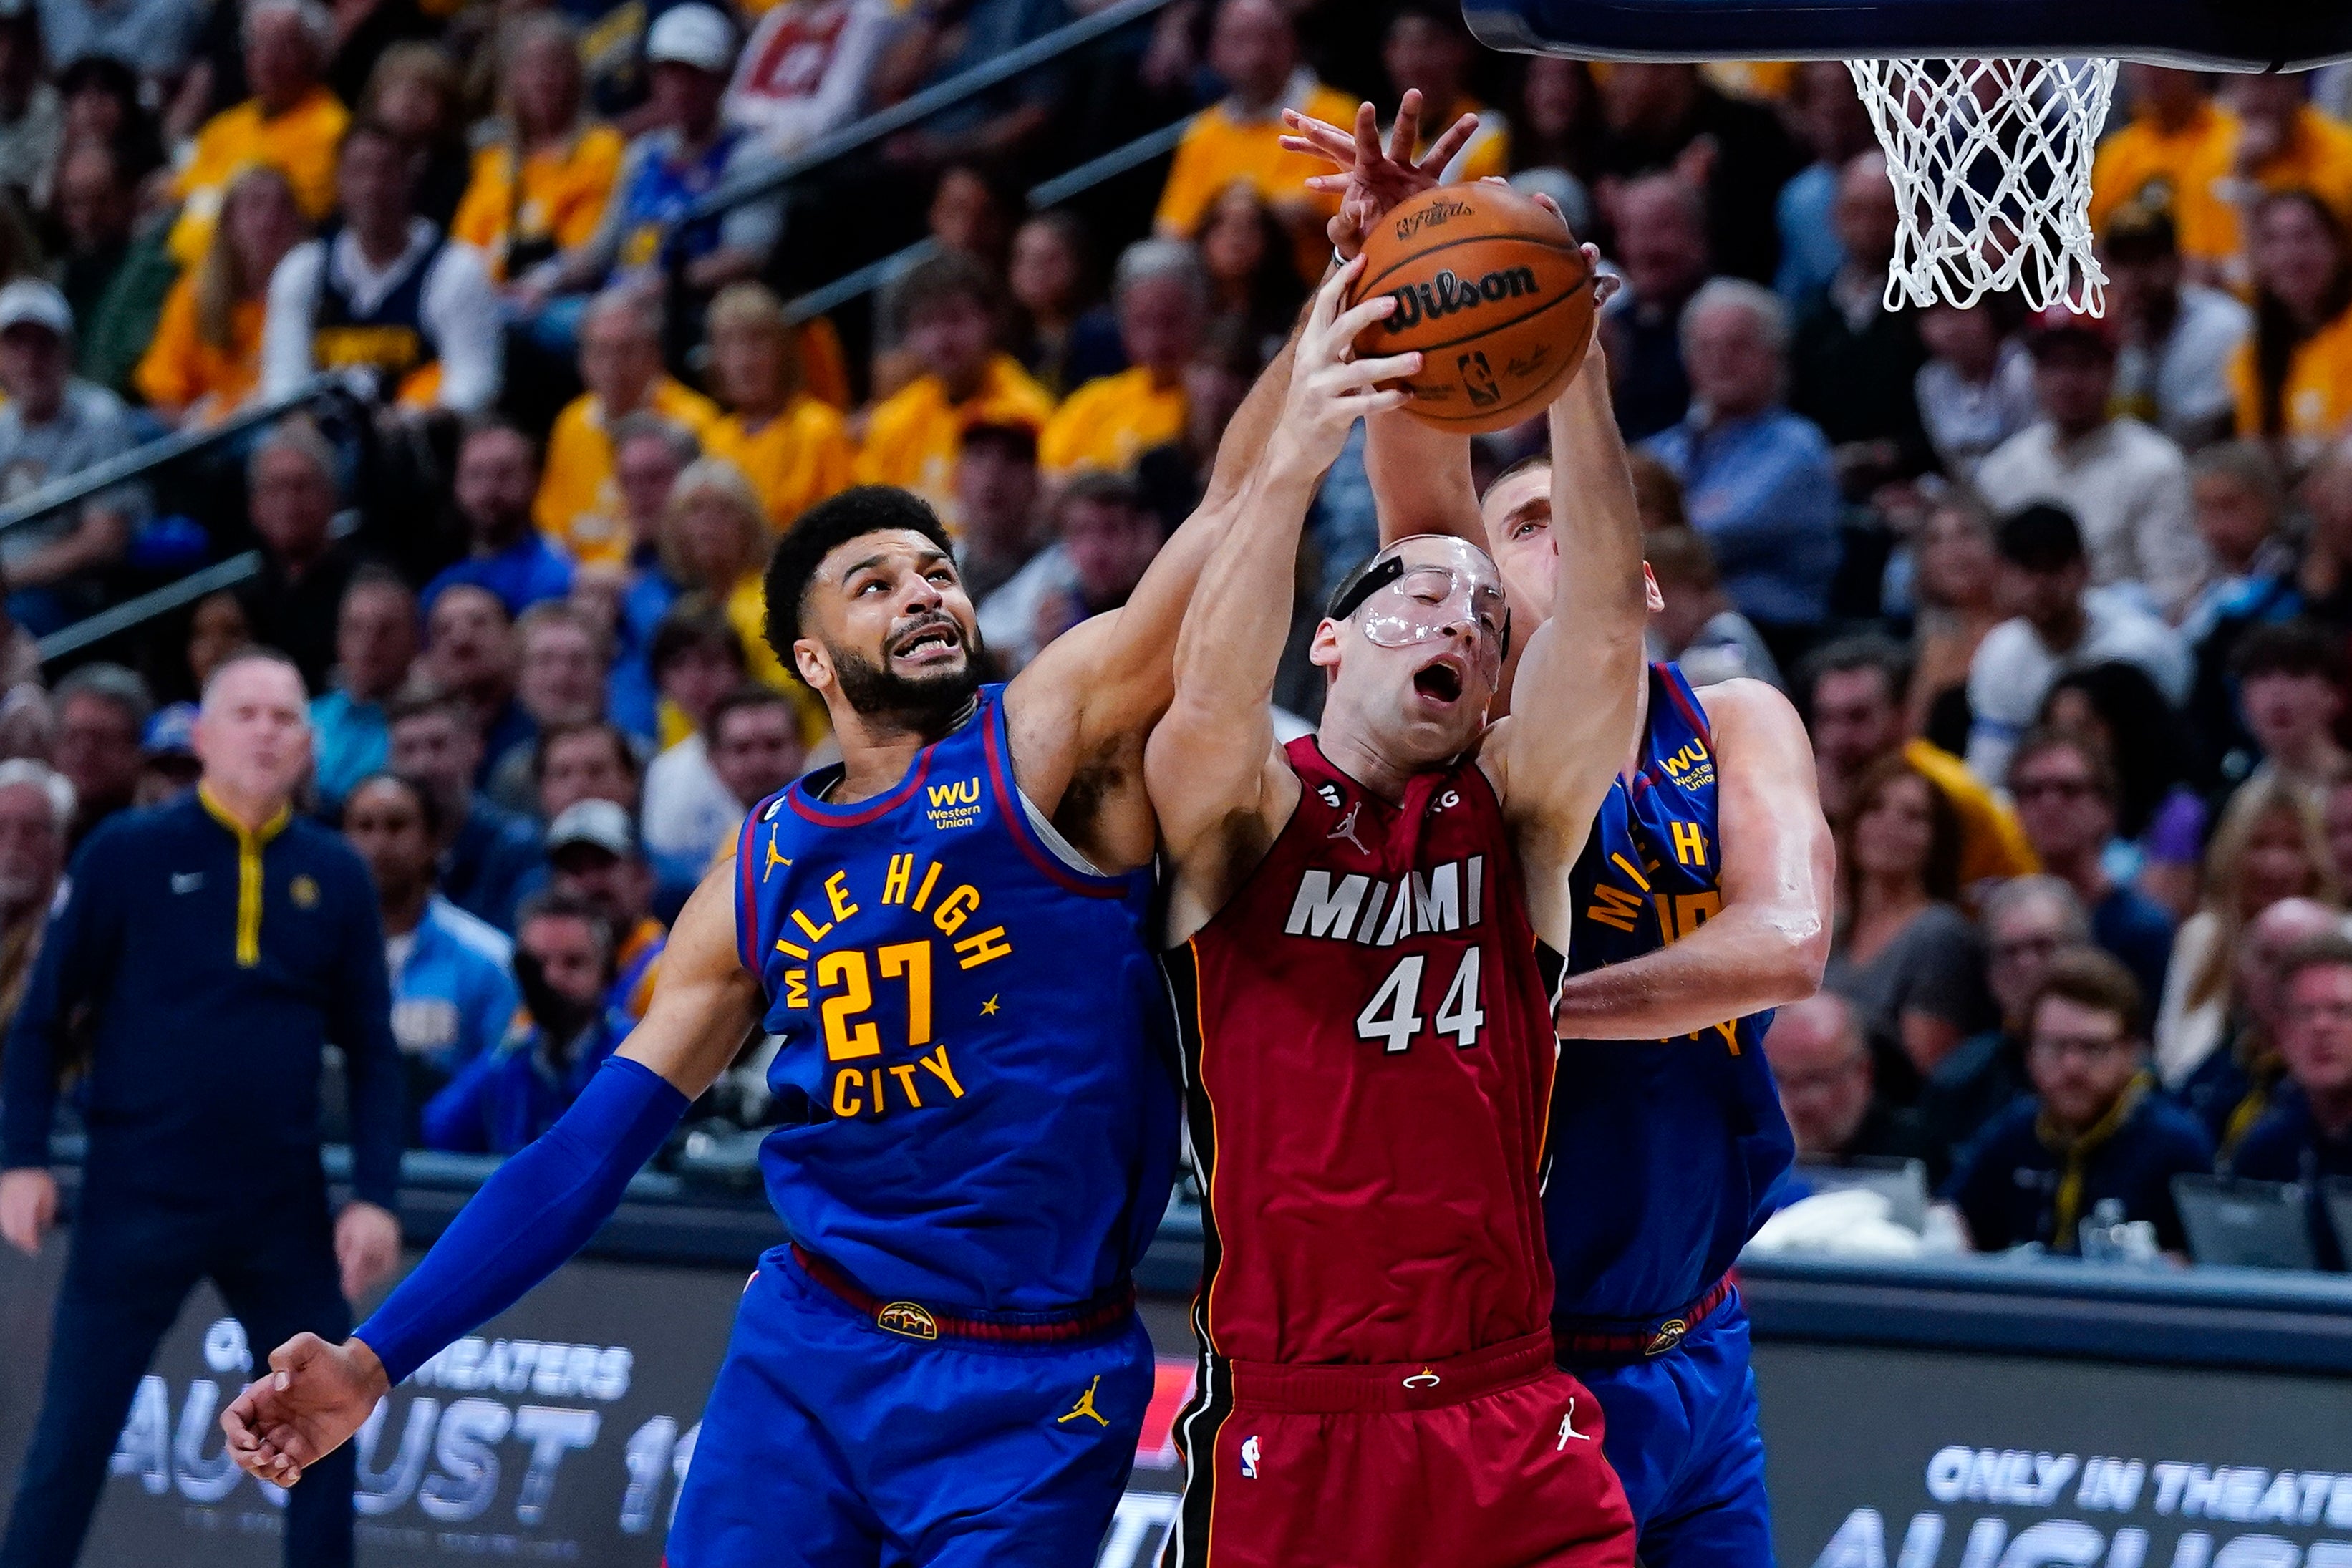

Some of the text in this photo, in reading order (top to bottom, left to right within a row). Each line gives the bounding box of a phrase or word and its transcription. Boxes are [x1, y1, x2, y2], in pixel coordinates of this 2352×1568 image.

[1382, 267, 1538, 334] Wilson
[926, 777, 980, 808] WU
[1657, 738, 1708, 778] WU
[926, 805, 981, 821] Western
[936, 817, 974, 830] Union
[775, 853, 1012, 1010] MILE HIGH
[1284, 855, 1483, 946] MIAMI
[816, 939, 932, 1063] 27
[1356, 946, 1484, 1052] 44
[833, 1045, 964, 1118] CITY
[111, 1375, 602, 1527] AUUST
[1926, 1446, 2078, 1506] ONLY
[2077, 1456, 2146, 1514] IN
